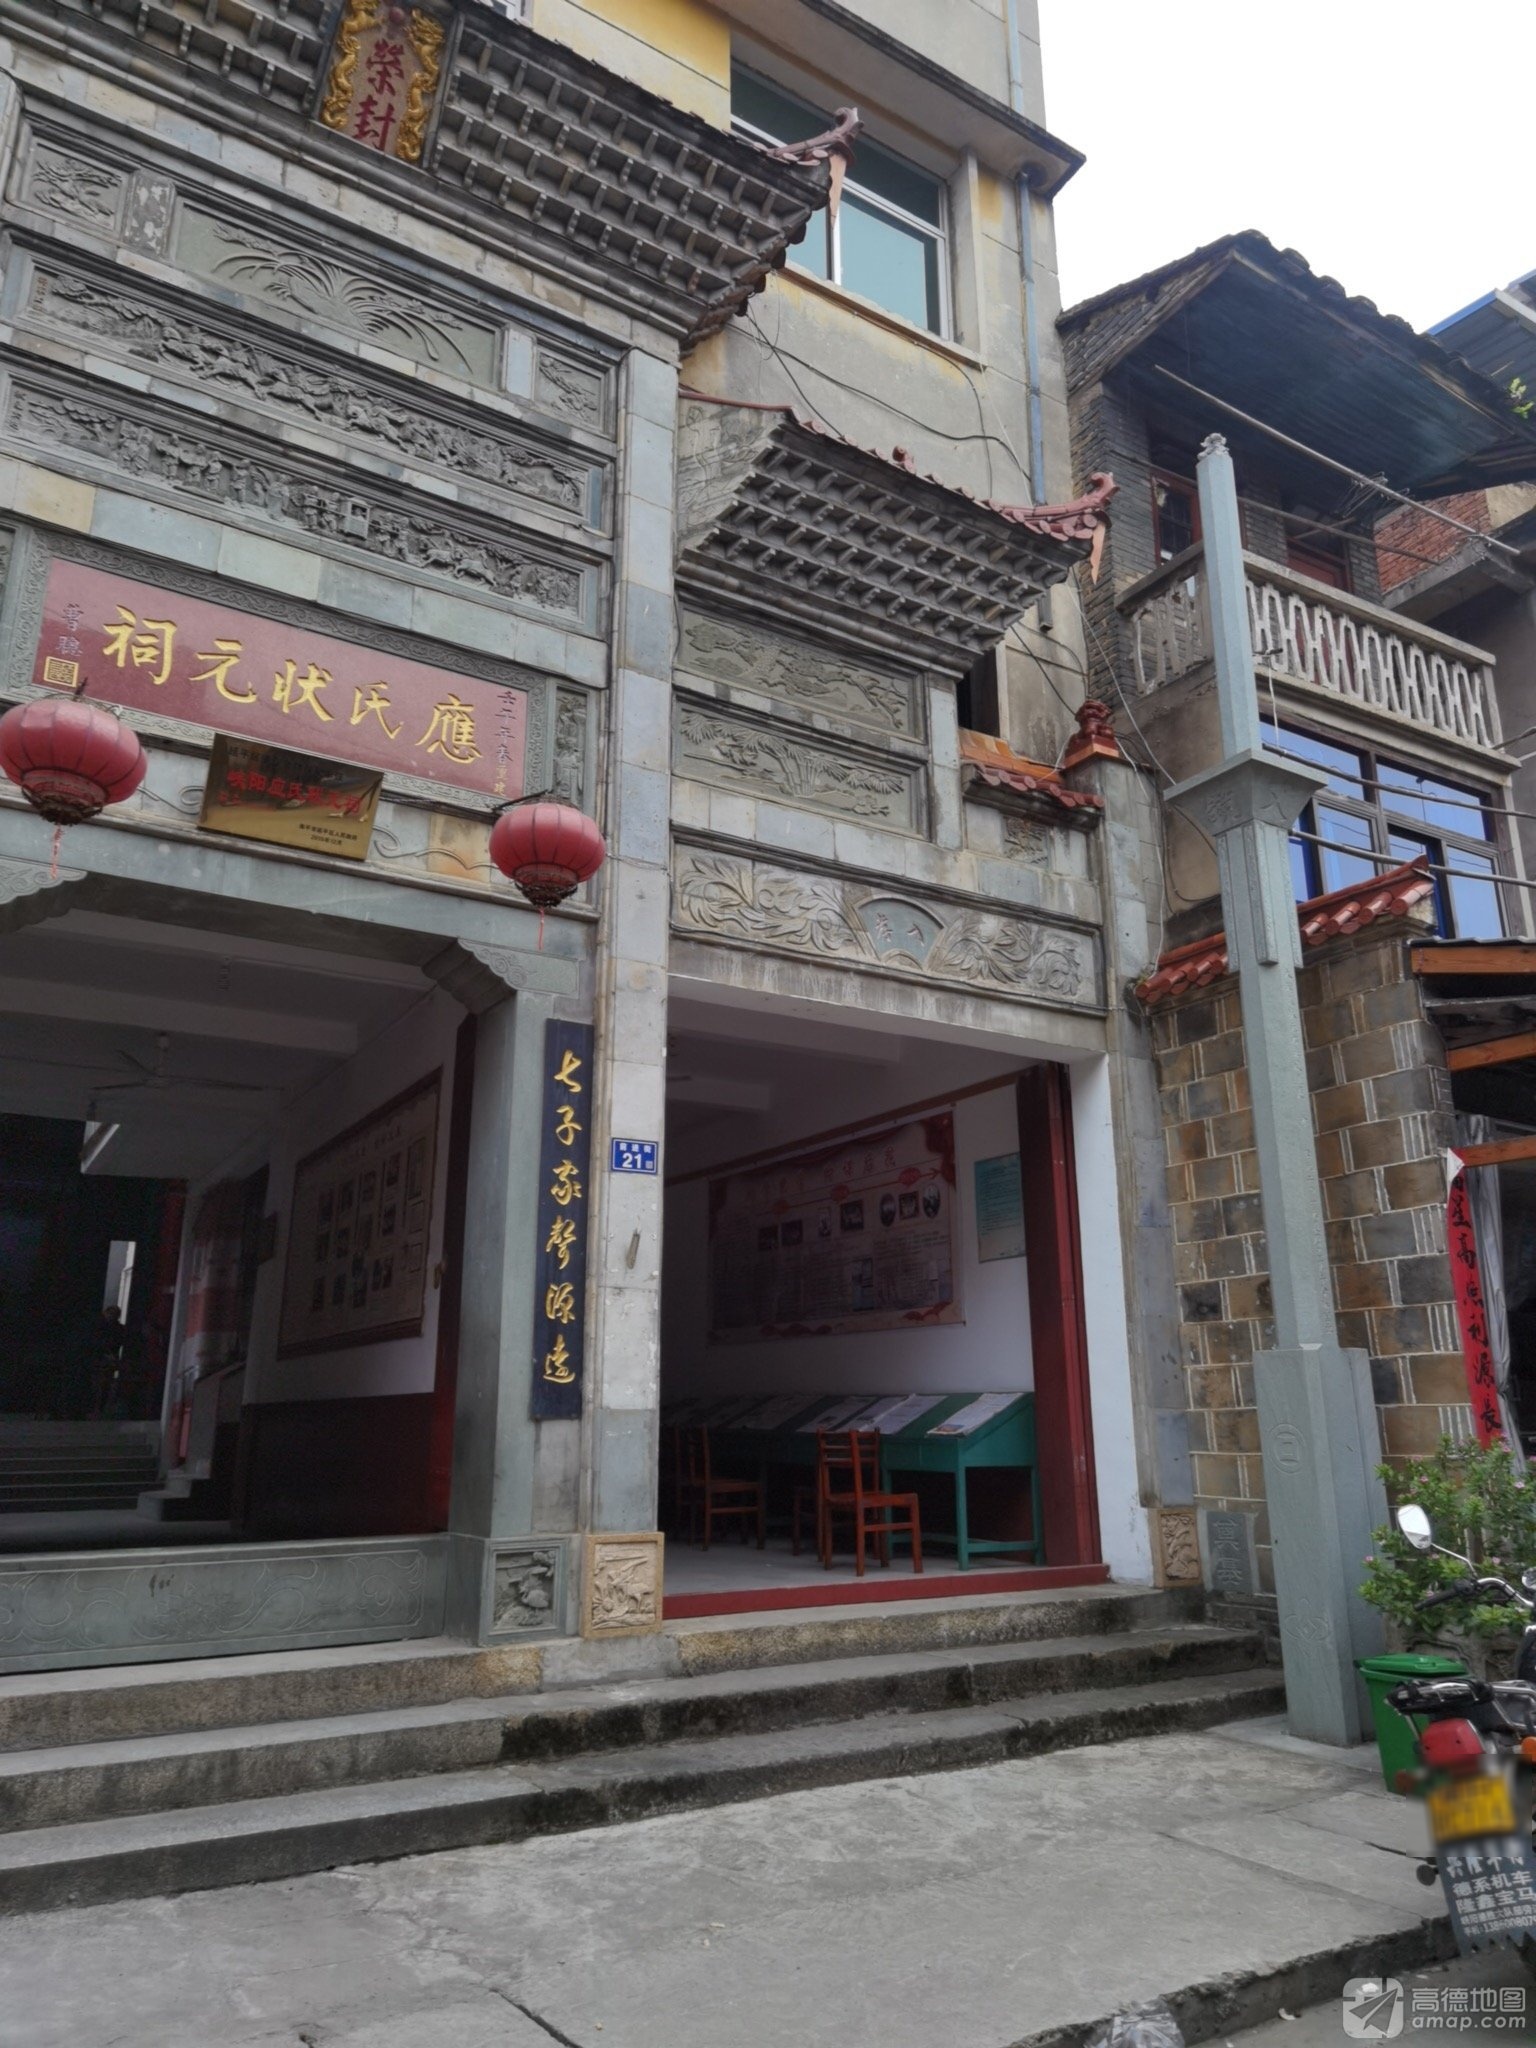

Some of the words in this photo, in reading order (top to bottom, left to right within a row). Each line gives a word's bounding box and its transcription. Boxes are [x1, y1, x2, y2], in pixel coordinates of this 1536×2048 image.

[622, 1152, 642, 1169] 21
[1453, 1870, 1534, 1898] 德系机车
[1456, 1887, 1536, 1915] 隆鑫宝马
